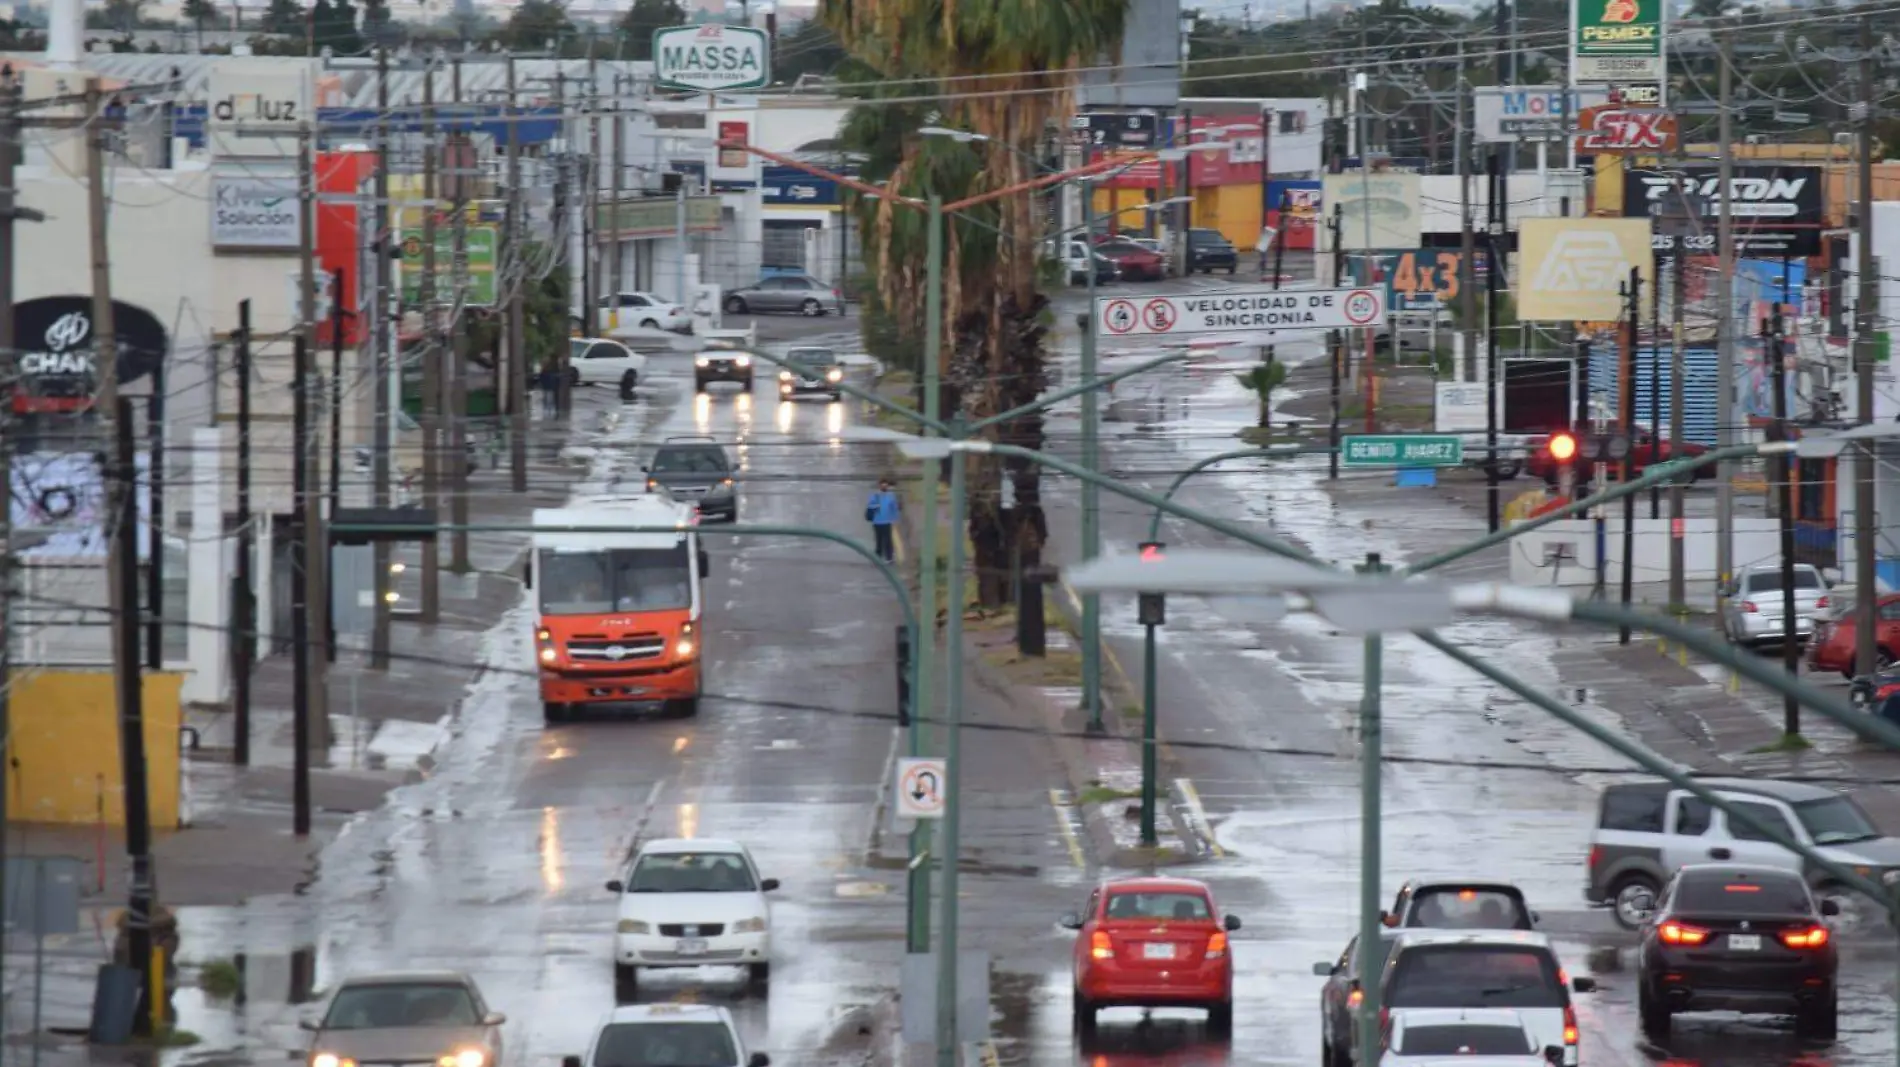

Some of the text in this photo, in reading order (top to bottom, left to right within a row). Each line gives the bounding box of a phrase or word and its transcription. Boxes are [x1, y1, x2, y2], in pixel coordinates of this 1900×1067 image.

[1582, 26, 1656, 40] PEMEX
[663, 46, 758, 70] MASSA
[1585, 110, 1666, 148] SIX
[217, 209, 295, 226] Solución
[1184, 295, 1334, 312] VELOCIDAD DE
[1205, 311, 1316, 326] SINCRONIA
[1350, 442, 1453, 459] BENITO JUAREZ
